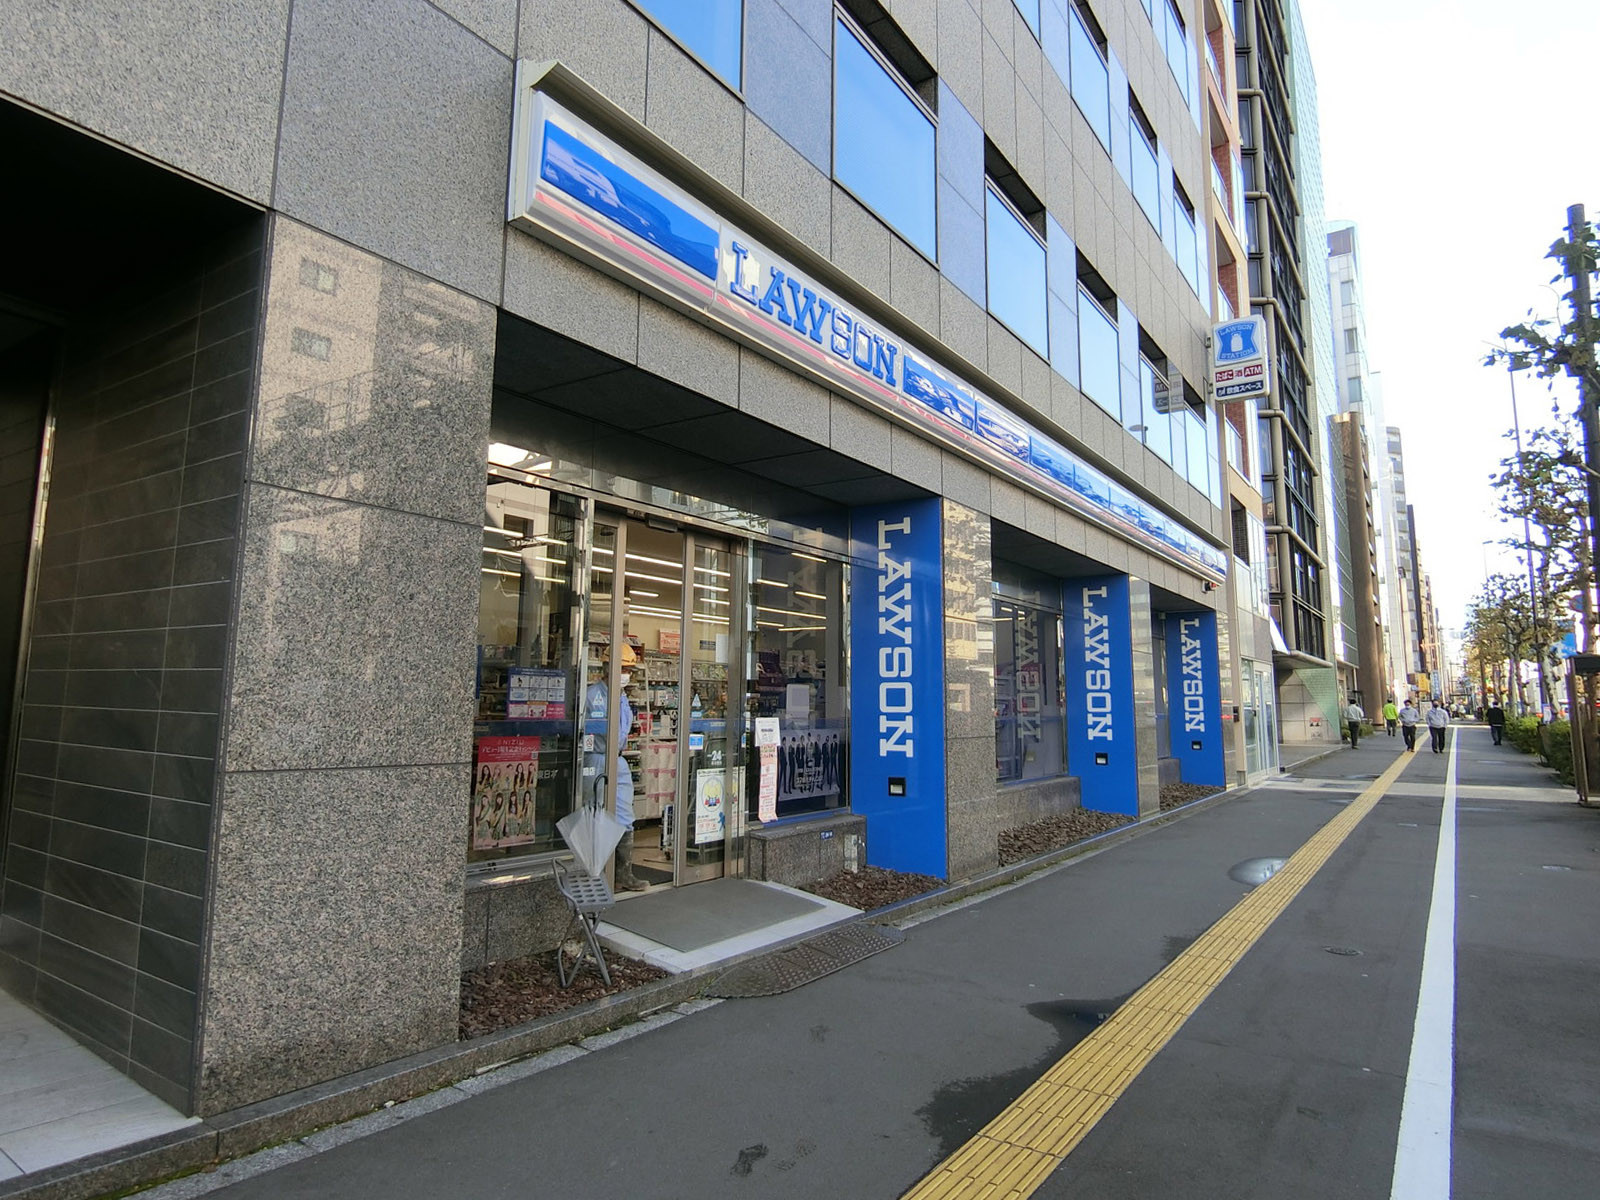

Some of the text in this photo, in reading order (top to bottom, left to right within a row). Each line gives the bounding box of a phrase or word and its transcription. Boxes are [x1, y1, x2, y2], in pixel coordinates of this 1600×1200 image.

[730, 240, 898, 386] LAWSON
[1219, 323, 1253, 336] LAWSON
[1220, 348, 1254, 359] STATION
[1216, 371, 1233, 381] たばこ
[1245, 366, 1262, 376] ATM
[878, 516, 914, 758] LAWSON
[1082, 585, 1113, 742] LAWSON
[1180, 617, 1206, 733] LAWSON
